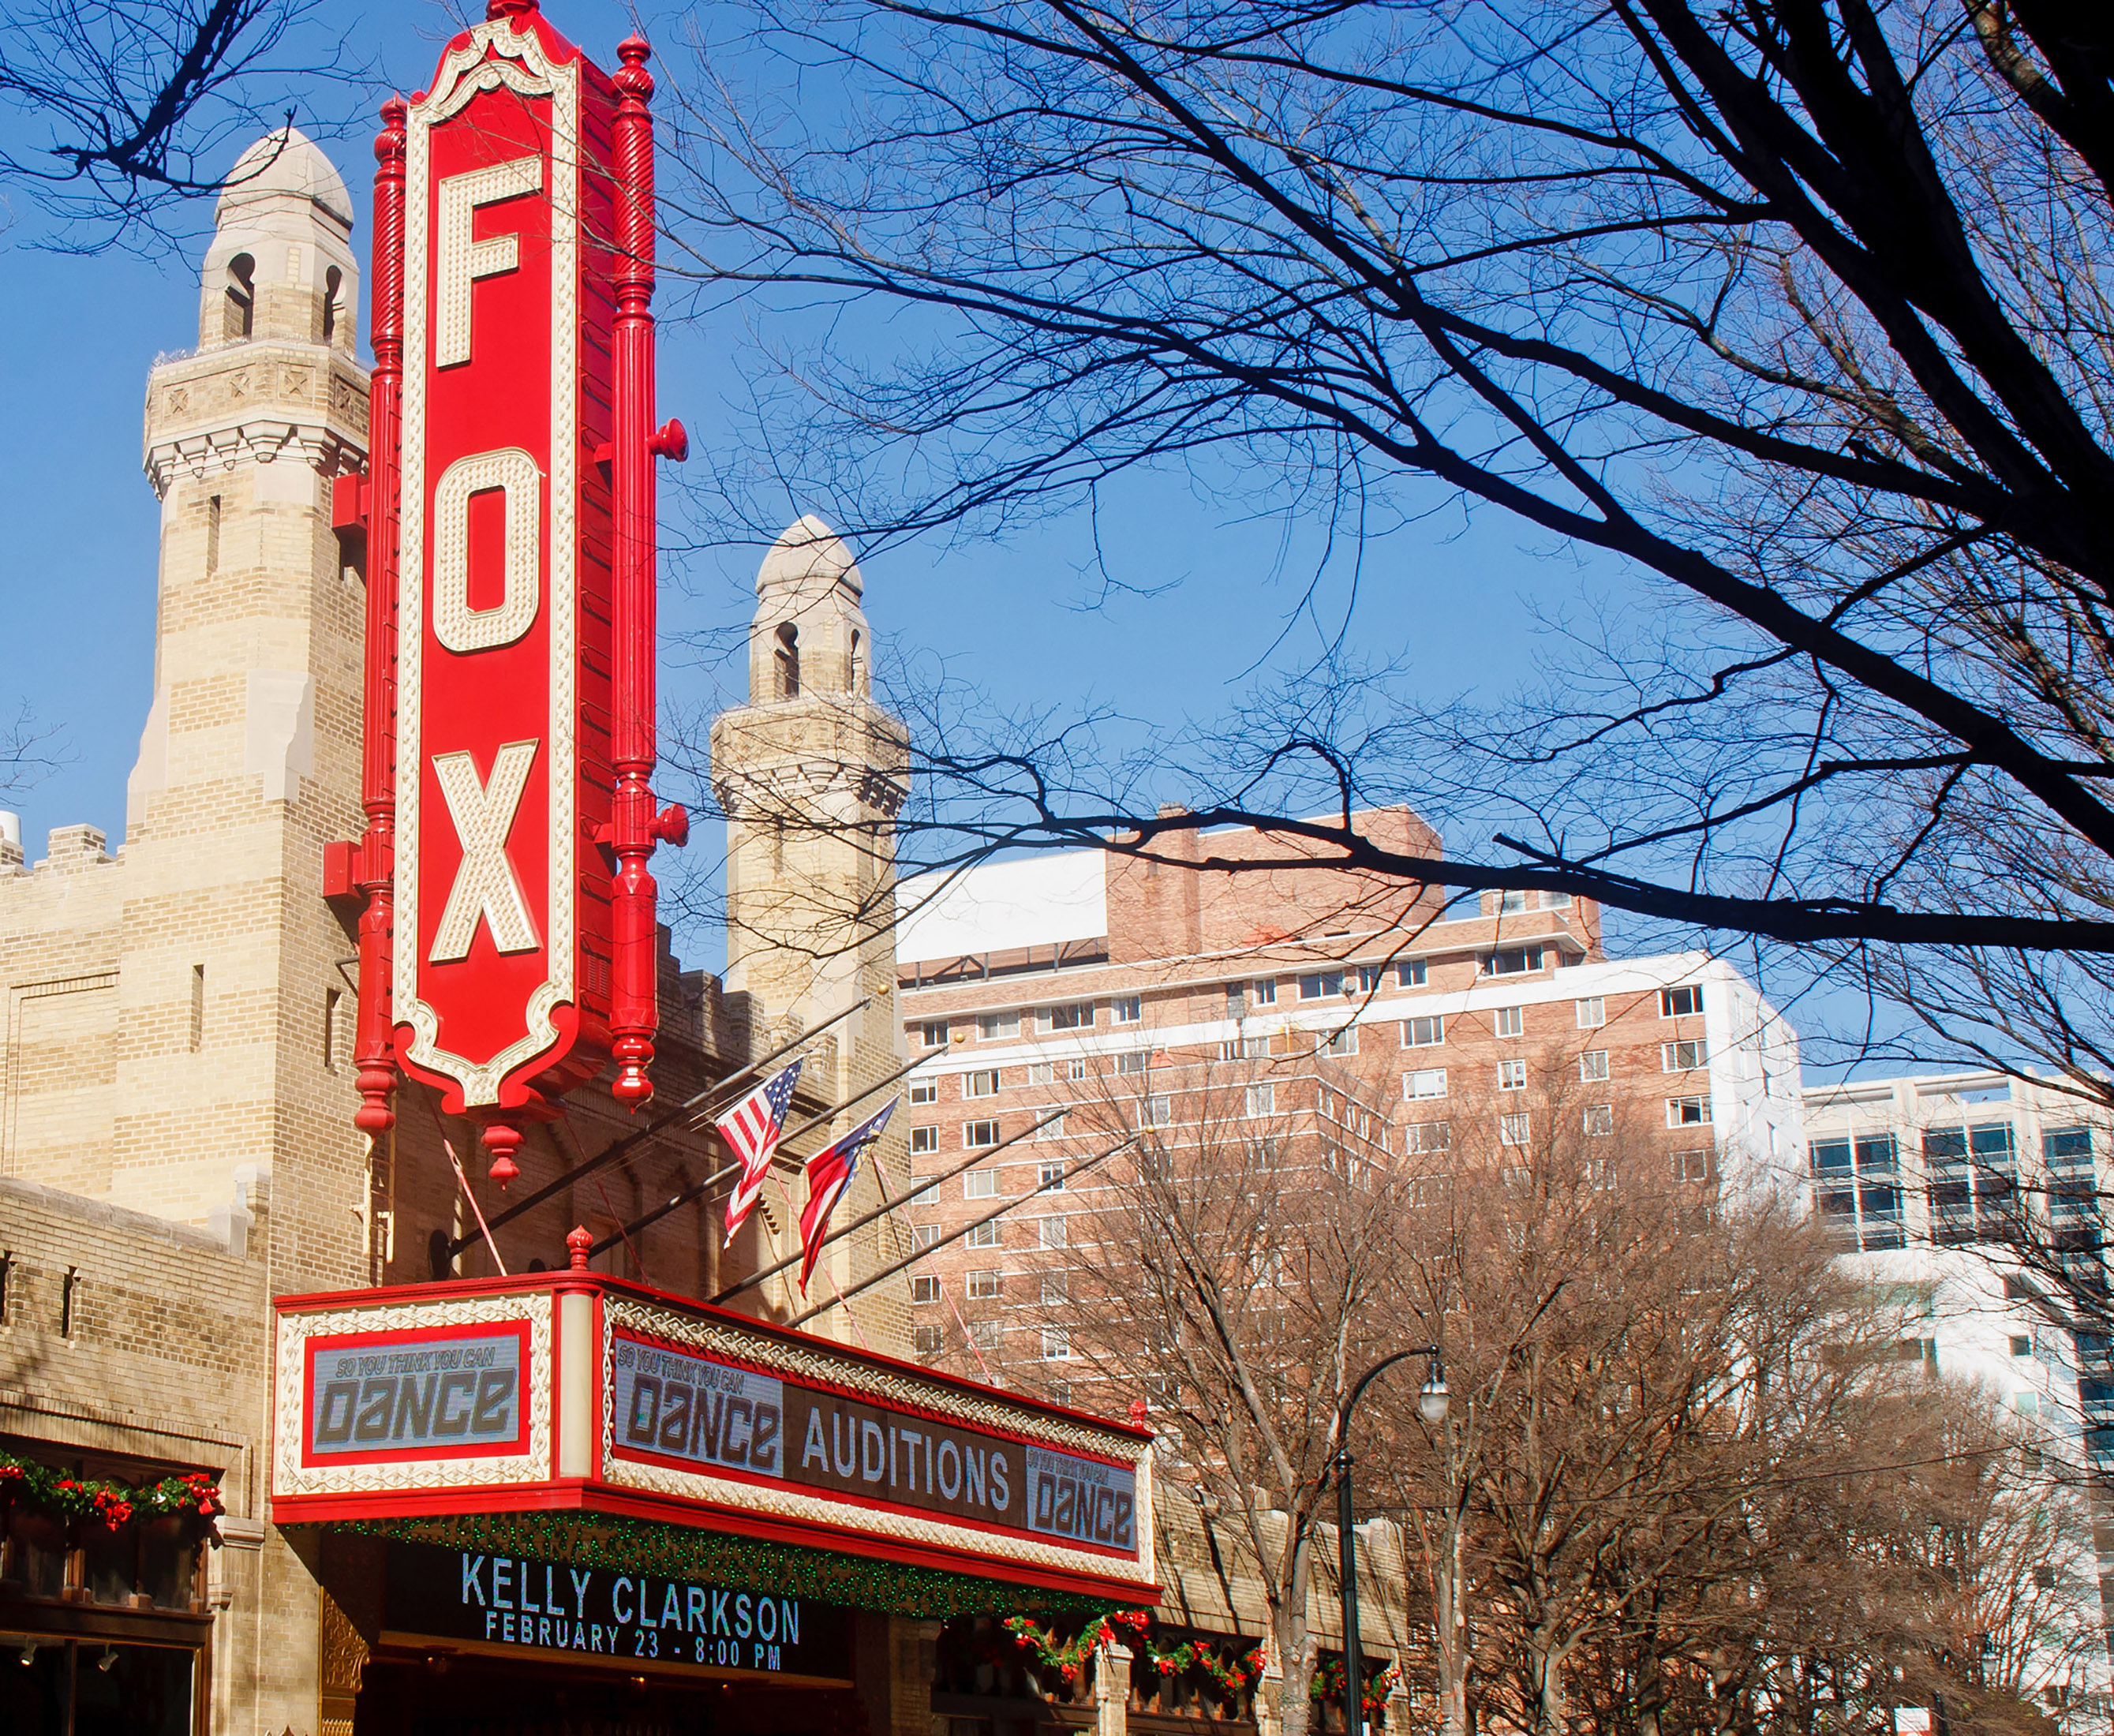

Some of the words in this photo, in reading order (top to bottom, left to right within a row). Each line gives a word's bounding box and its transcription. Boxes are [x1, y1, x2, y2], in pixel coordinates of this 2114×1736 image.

[428, 155, 544, 964] FOX
[335, 1357, 357, 1378] SO
[358, 1355, 387, 1376] YOU
[387, 1352, 432, 1375] THINK
[431, 1349, 463, 1370] YOU
[462, 1347, 496, 1368] CAN
[618, 1345, 635, 1367] SO
[636, 1349, 661, 1374] YOU
[660, 1356, 698, 1385] THINK
[696, 1364, 721, 1389] YOU
[720, 1371, 746, 1395] CAN
[802, 1406, 1010, 1511] AUDITIONS
[462, 1552, 592, 1618] KELLY
[612, 1577, 799, 1644] CLARKSON
[485, 1611, 619, 1654] FEBRUARY
[634, 1629, 658, 1657] 23
[695, 1636, 739, 1666] 8:00
[754, 1642, 781, 1671] PM
